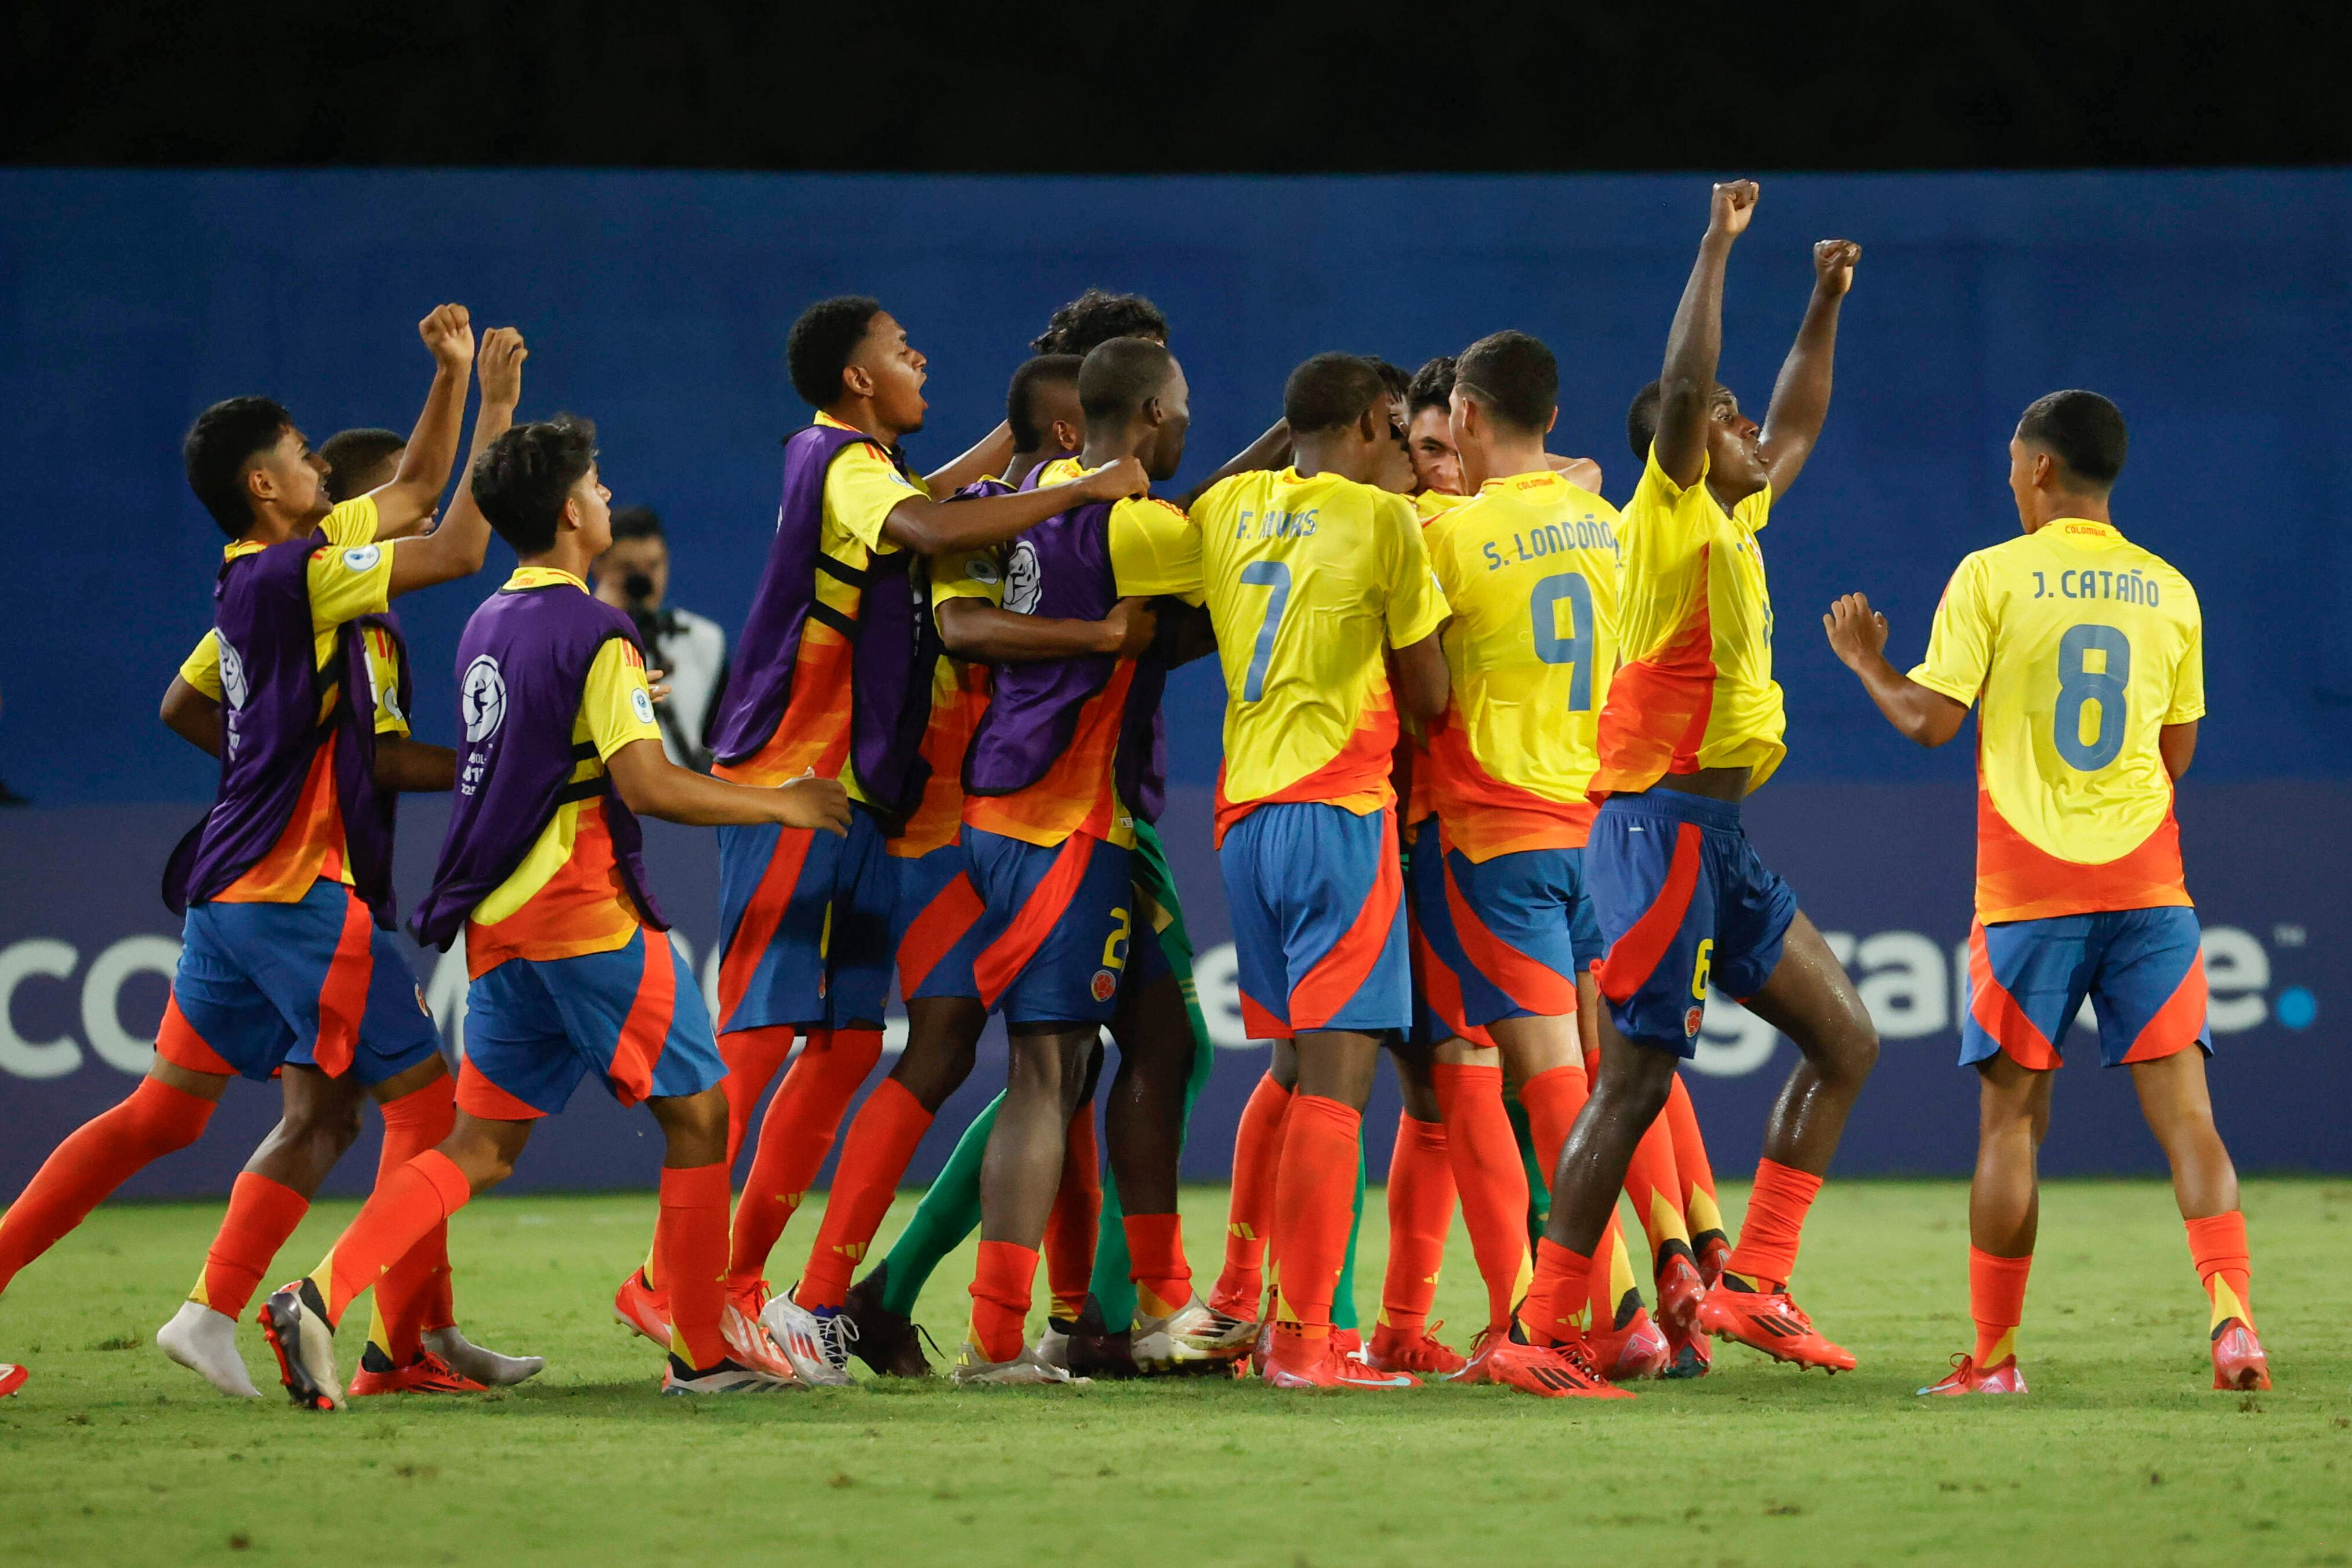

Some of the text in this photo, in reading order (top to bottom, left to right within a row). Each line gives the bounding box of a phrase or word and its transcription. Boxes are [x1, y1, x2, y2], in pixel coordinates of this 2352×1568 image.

[1236, 510, 1253, 539] F.
[1483, 541, 1510, 571] S.
[2064, 525, 2107, 538] COLOMBIA
[2032, 568, 2159, 608] J. CATAÑO
[1239, 560, 1291, 703] 7
[1530, 572, 1594, 712] 9
[2053, 623, 2131, 772] 8
[1102, 907, 1129, 970] 2
[1691, 938, 1714, 1001] 6
